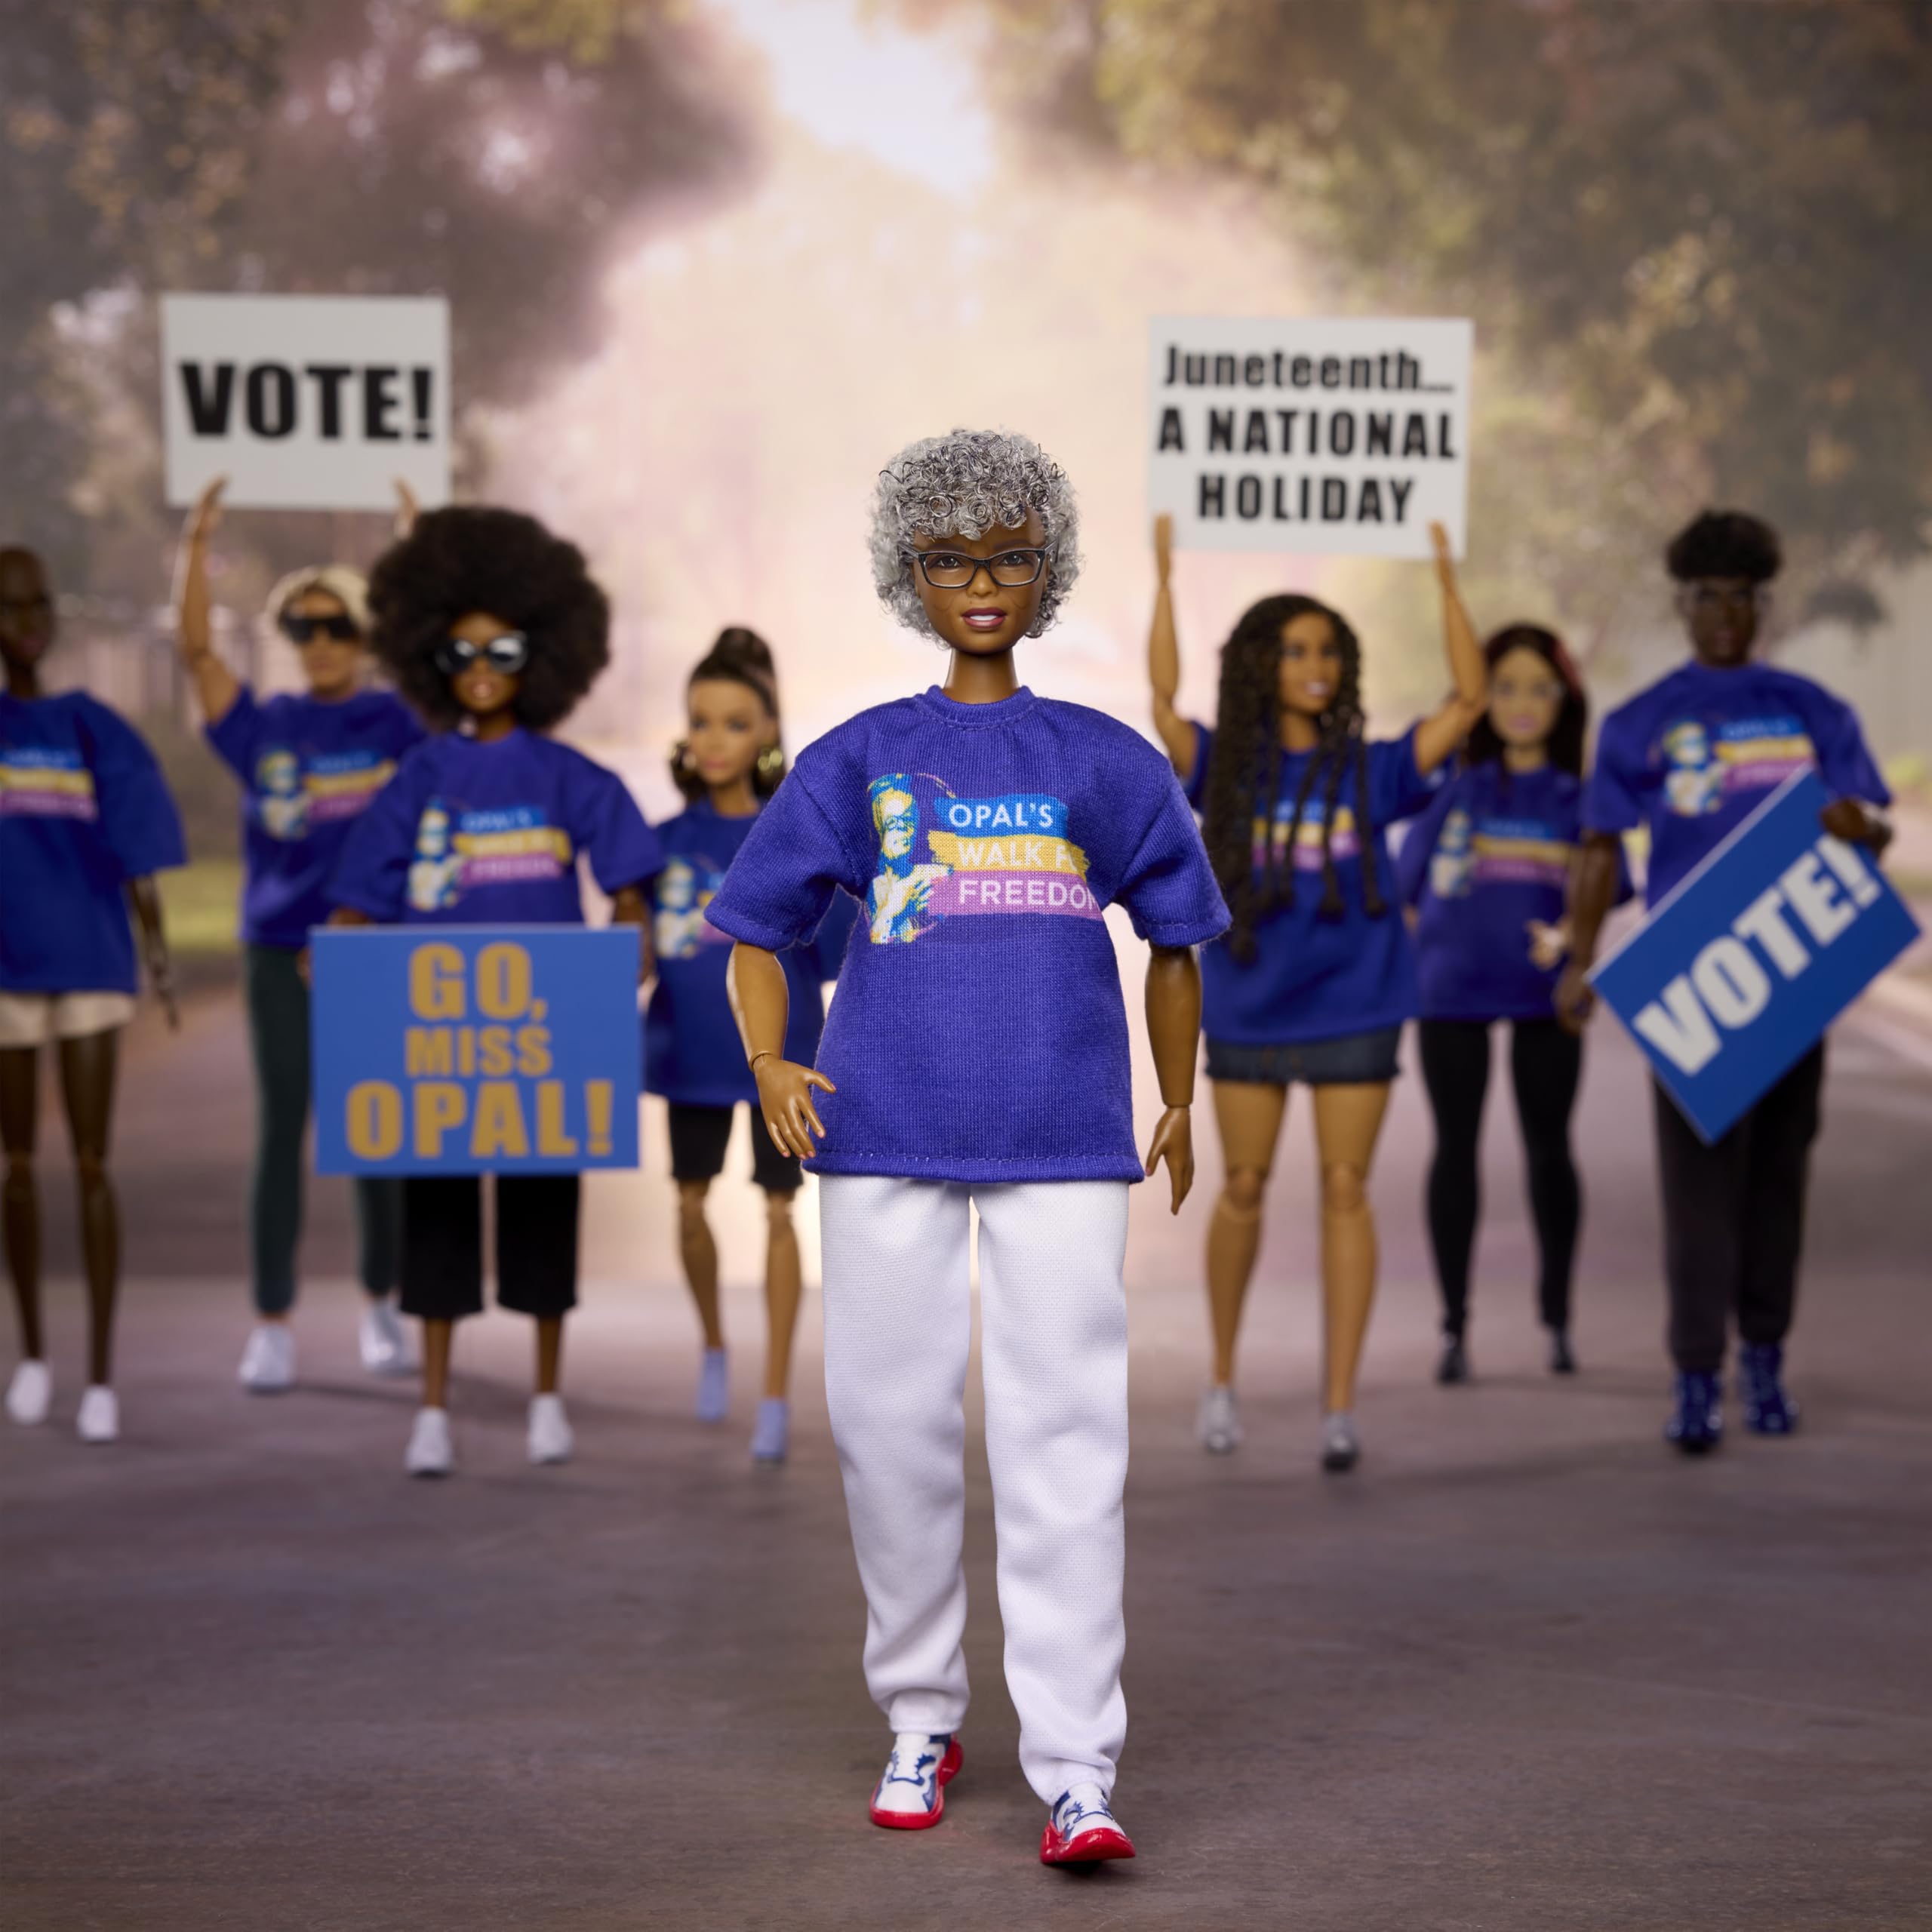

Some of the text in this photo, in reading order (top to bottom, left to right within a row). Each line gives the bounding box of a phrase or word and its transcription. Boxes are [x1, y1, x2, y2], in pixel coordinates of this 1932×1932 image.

[180, 361, 432, 442] VOTE!
[1158, 407, 1456, 459] A NATIONAL
[1198, 472, 1413, 523] HOLIDAY
[949, 803, 1054, 829] OPAL'S
[957, 841, 1044, 868] WALK
[409, 942, 548, 1022] GO,
[1632, 834, 1881, 1077] VOTE!
[405, 1025, 553, 1078] MISS
[346, 1078, 614, 1161] OPAL!
